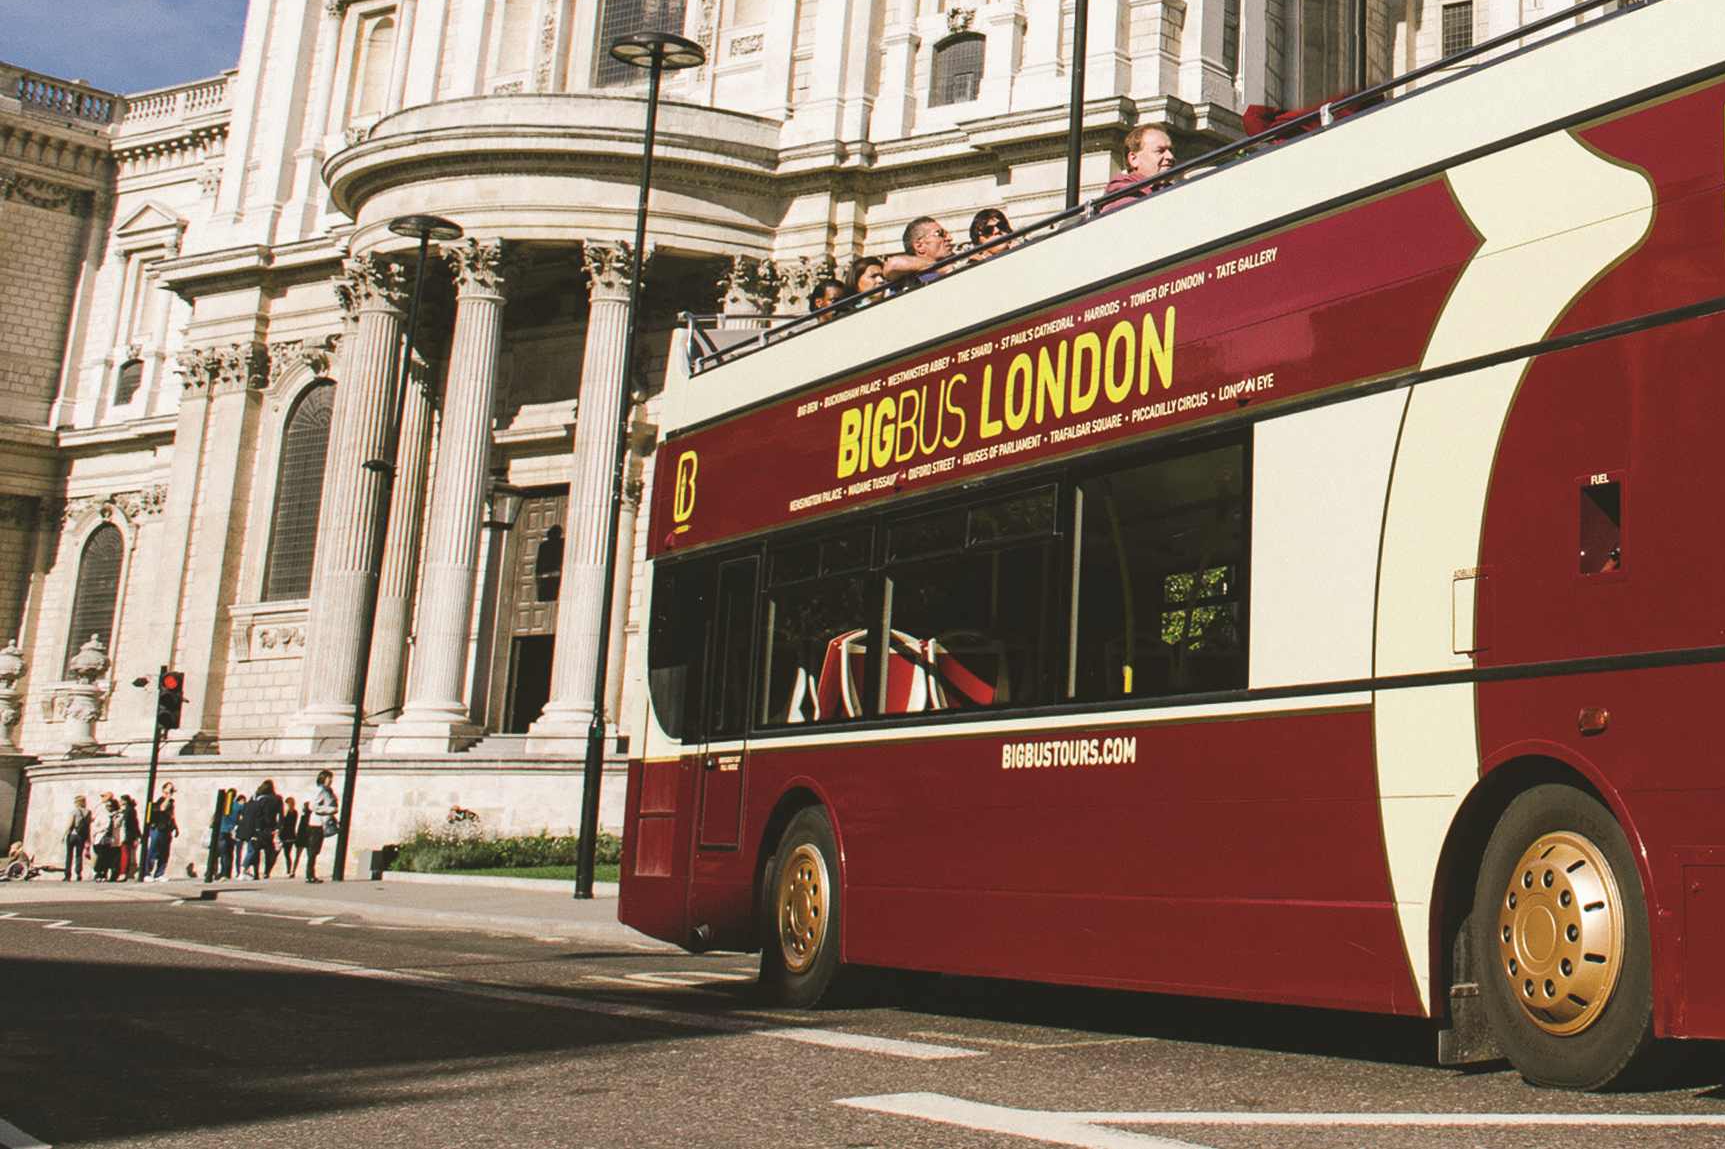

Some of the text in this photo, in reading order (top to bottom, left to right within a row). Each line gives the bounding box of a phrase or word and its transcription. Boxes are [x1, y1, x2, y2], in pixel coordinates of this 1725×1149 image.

[887, 363, 929, 387] WESTMINSTER
[929, 356, 950, 373] ABBEY
[957, 350, 970, 364] THE
[970, 342, 993, 360] SHARD
[1000, 337, 1011, 350] ST
[1010, 328, 1034, 347] PAUL'S
[1034, 315, 1075, 339] CATHEDRAL
[1083, 301, 1120, 323] HARRODS
[1130, 287, 1157, 308] TOWER
[1158, 282, 1169, 298] OF
[1170, 271, 1205, 295] LONDON
[1216, 260, 1237, 279] TATE
[1238, 247, 1278, 272] GALLERY
[837, 306, 1176, 479] BIGBUS LONDON
[908, 463, 932, 481] OXFORD
[932, 456, 956, 474] STREET
[962, 446, 989, 466] HOUSES
[989, 443, 999, 460] OF
[998, 434, 1042, 456] PARLIAMENT
[1050, 422, 1092, 444] TRAFALGAR
[1092, 413, 1123, 436] SQUARE
[1131, 399, 1177, 424] PICCADILLY
[1177, 391, 1209, 413] CIRCUS
[1257, 373, 1274, 391] EYE
[1590, 473, 1610, 486] FUEL
[1002, 736, 1137, 769] BIGBUSTOURS.COM
